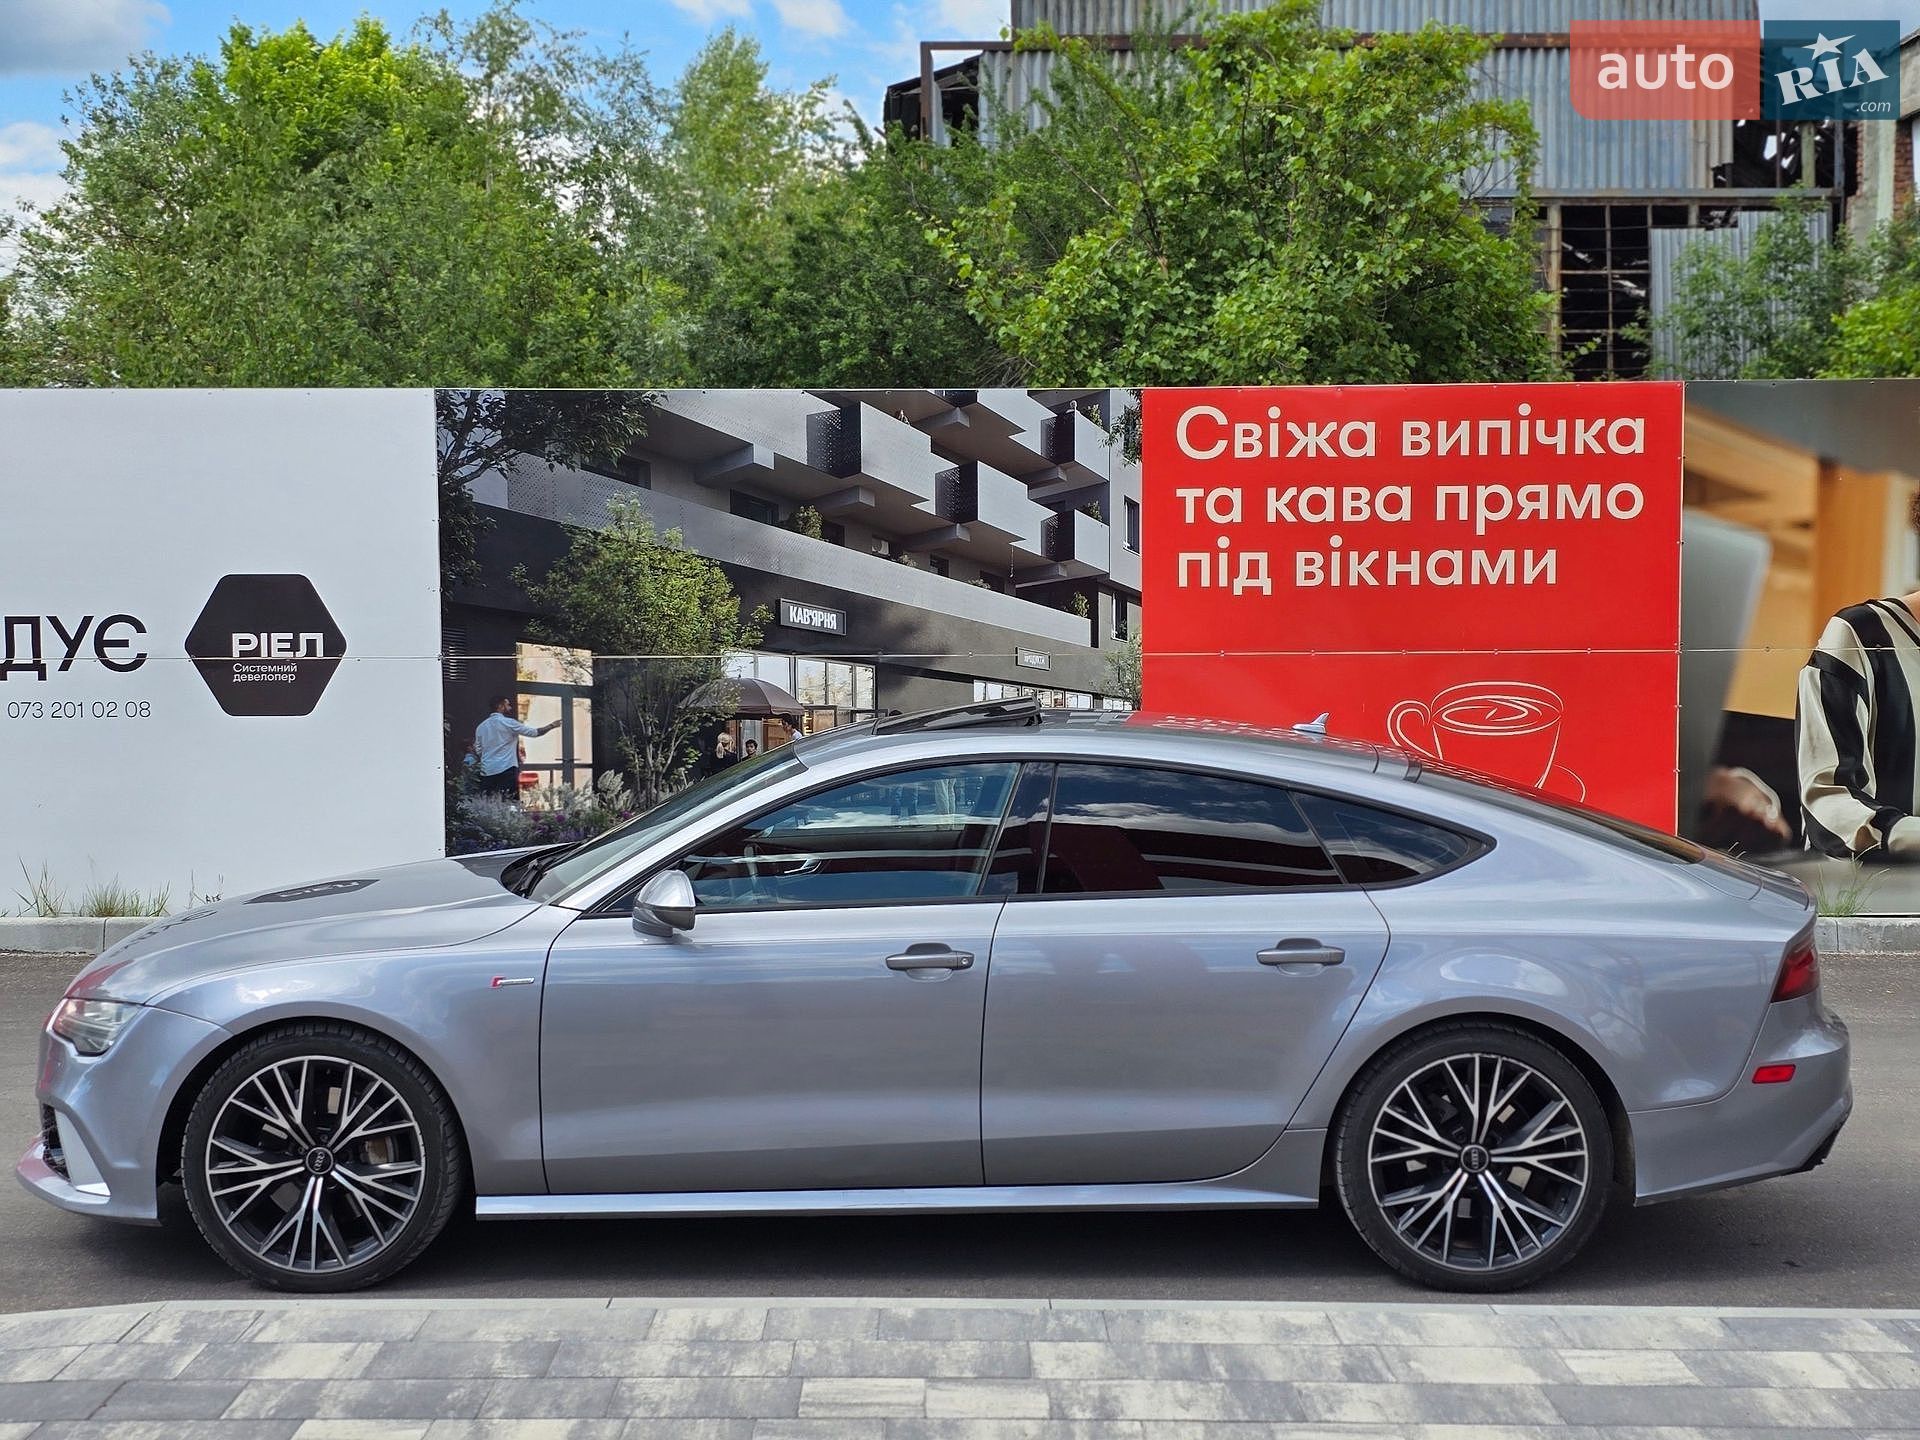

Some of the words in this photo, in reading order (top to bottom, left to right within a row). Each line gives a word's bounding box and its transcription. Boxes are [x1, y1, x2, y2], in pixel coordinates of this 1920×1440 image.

[1176, 405, 1377, 460] Свіжа
[1402, 403, 1646, 457] випічка
[1176, 486, 1242, 524] та
[1267, 485, 1411, 524] кава
[1436, 481, 1644, 536] прямо
[1178, 536, 1272, 596] під
[1296, 534, 1557, 587] вікнами
[232, 632, 324, 658] РІЕЛ
[232, 662, 298, 673] Системний
[232, 673, 296, 683] девелопер
[7, 701, 44, 718] 073
[51, 701, 84, 718] 201
[92, 701, 119, 718] 02
[125, 701, 151, 718] 08
